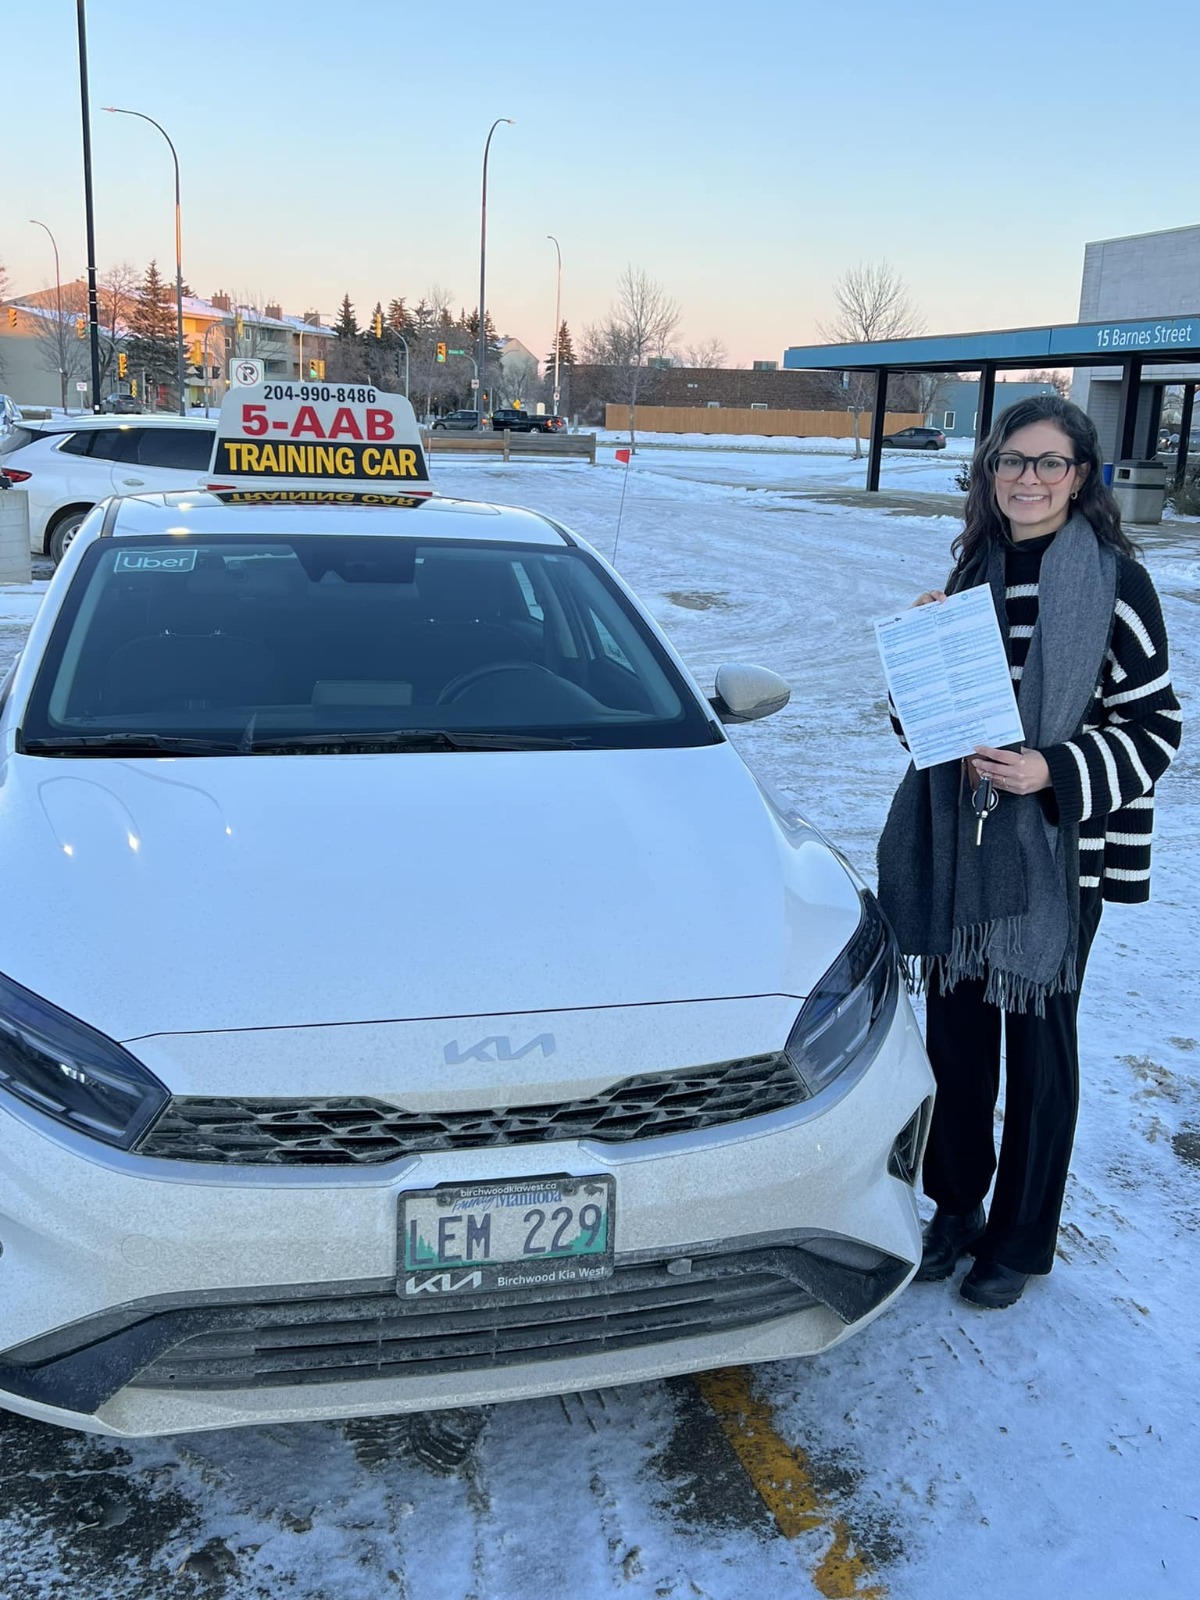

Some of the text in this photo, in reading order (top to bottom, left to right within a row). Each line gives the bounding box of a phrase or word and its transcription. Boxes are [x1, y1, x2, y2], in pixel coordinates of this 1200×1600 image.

[1097, 324, 1192, 347] 15 Barnes Street
[264, 385, 376, 403] 204-990-8486
[242, 404, 395, 441] 5-AAB
[224, 443, 418, 476] TRAINING CAR
[123, 556, 189, 568] Uber
[443, 1033, 556, 1065] KIA
[460, 1183, 557, 1198] birchwoodkiawest.ca
[410, 1203, 602, 1265] LEM 229
[405, 1270, 482, 1295] KIA
[497, 1266, 605, 1286] Birchwood Kia West
